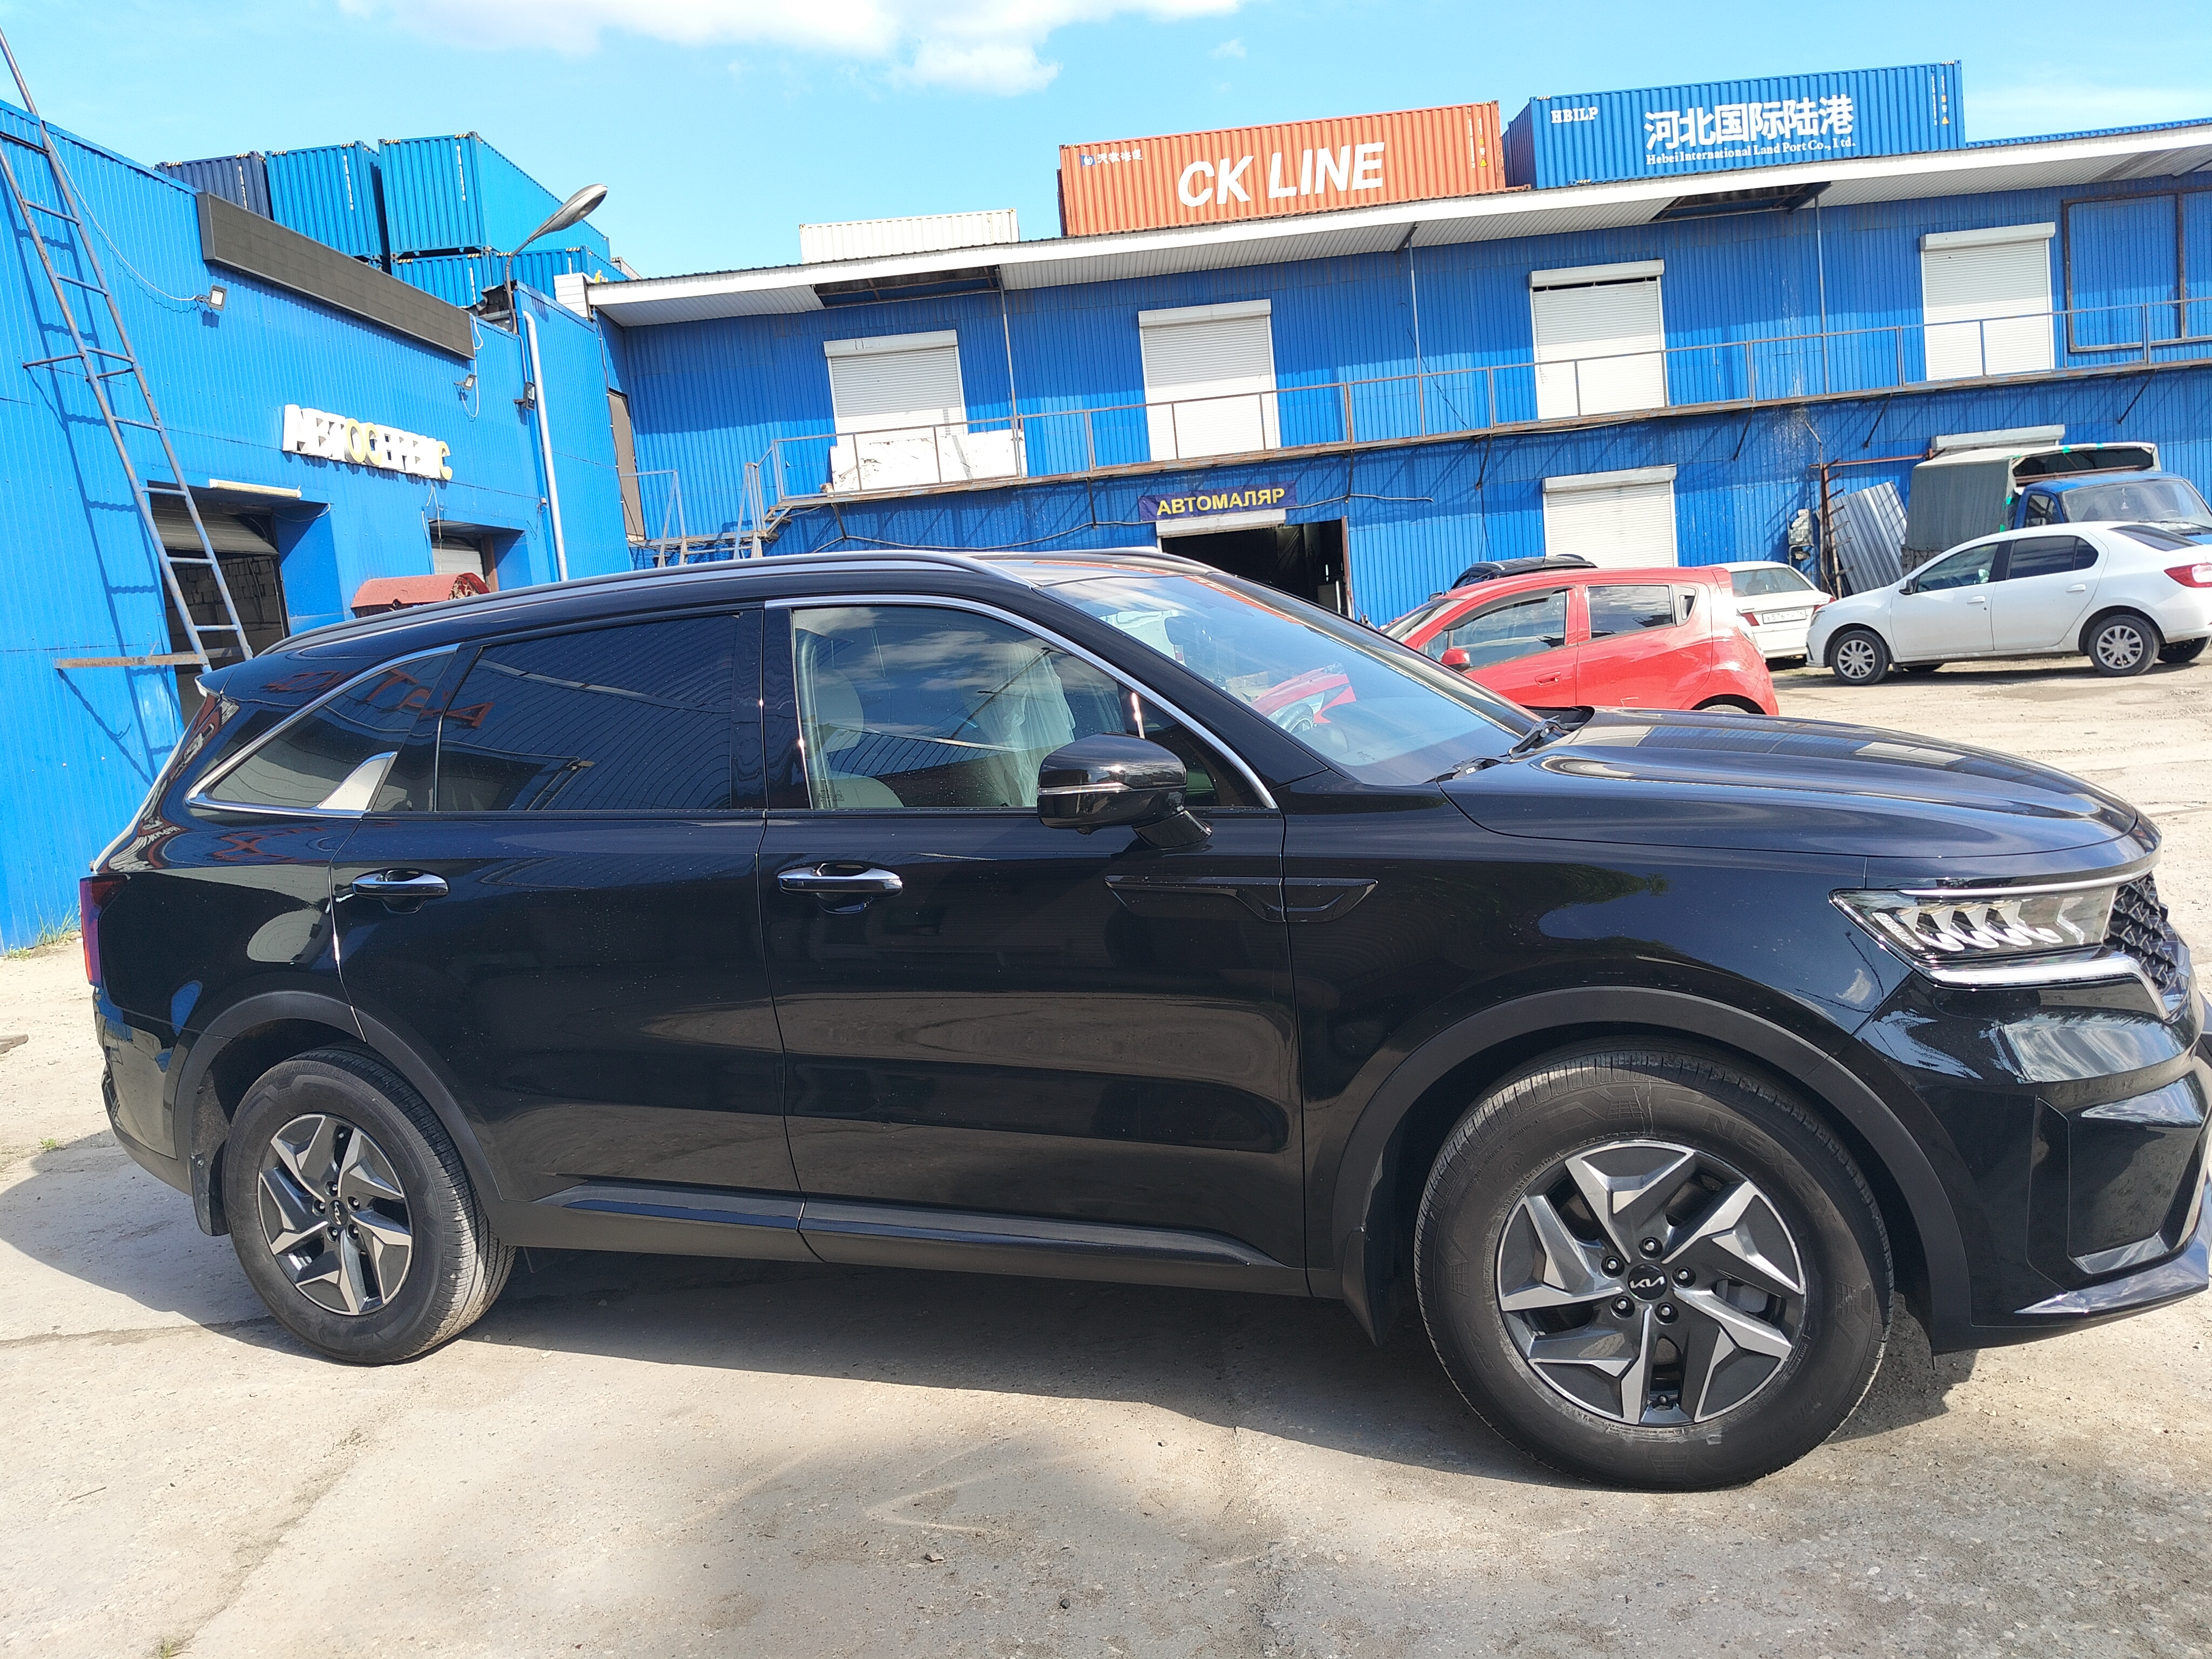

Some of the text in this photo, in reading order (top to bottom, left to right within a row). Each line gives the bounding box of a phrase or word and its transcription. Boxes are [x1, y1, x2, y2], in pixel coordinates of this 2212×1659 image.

[1551, 106, 1599, 124] HBILP
[1644, 93, 1854, 151] 河北国际陆港
[1645, 151, 1679, 165] Hebei
[1680, 145, 1751, 162] International
[1753, 143, 1781, 156] Land
[1782, 141, 1807, 153] Port
[1808, 139, 1832, 151] Co.,
[1178, 141, 1385, 208] CK LINE
[1156, 488, 1285, 516] АВТОМАЛЯР
